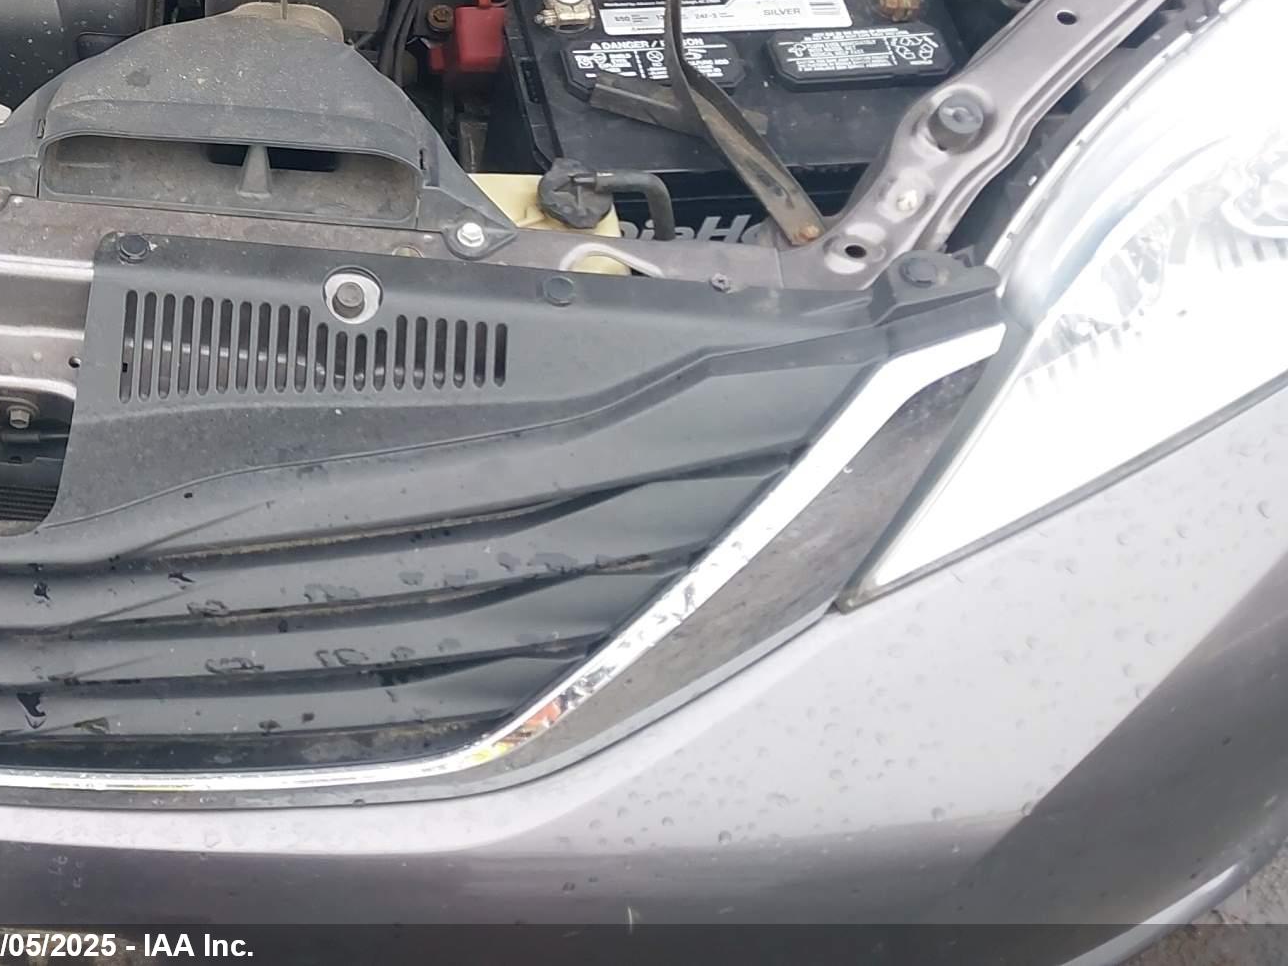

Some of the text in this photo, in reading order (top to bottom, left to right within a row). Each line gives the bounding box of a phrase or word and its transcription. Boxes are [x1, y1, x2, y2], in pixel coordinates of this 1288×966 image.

[763, 7, 801, 17] SILVER
[601, 40, 649, 50] DANGER
[660, 37, 705, 47] PSON
